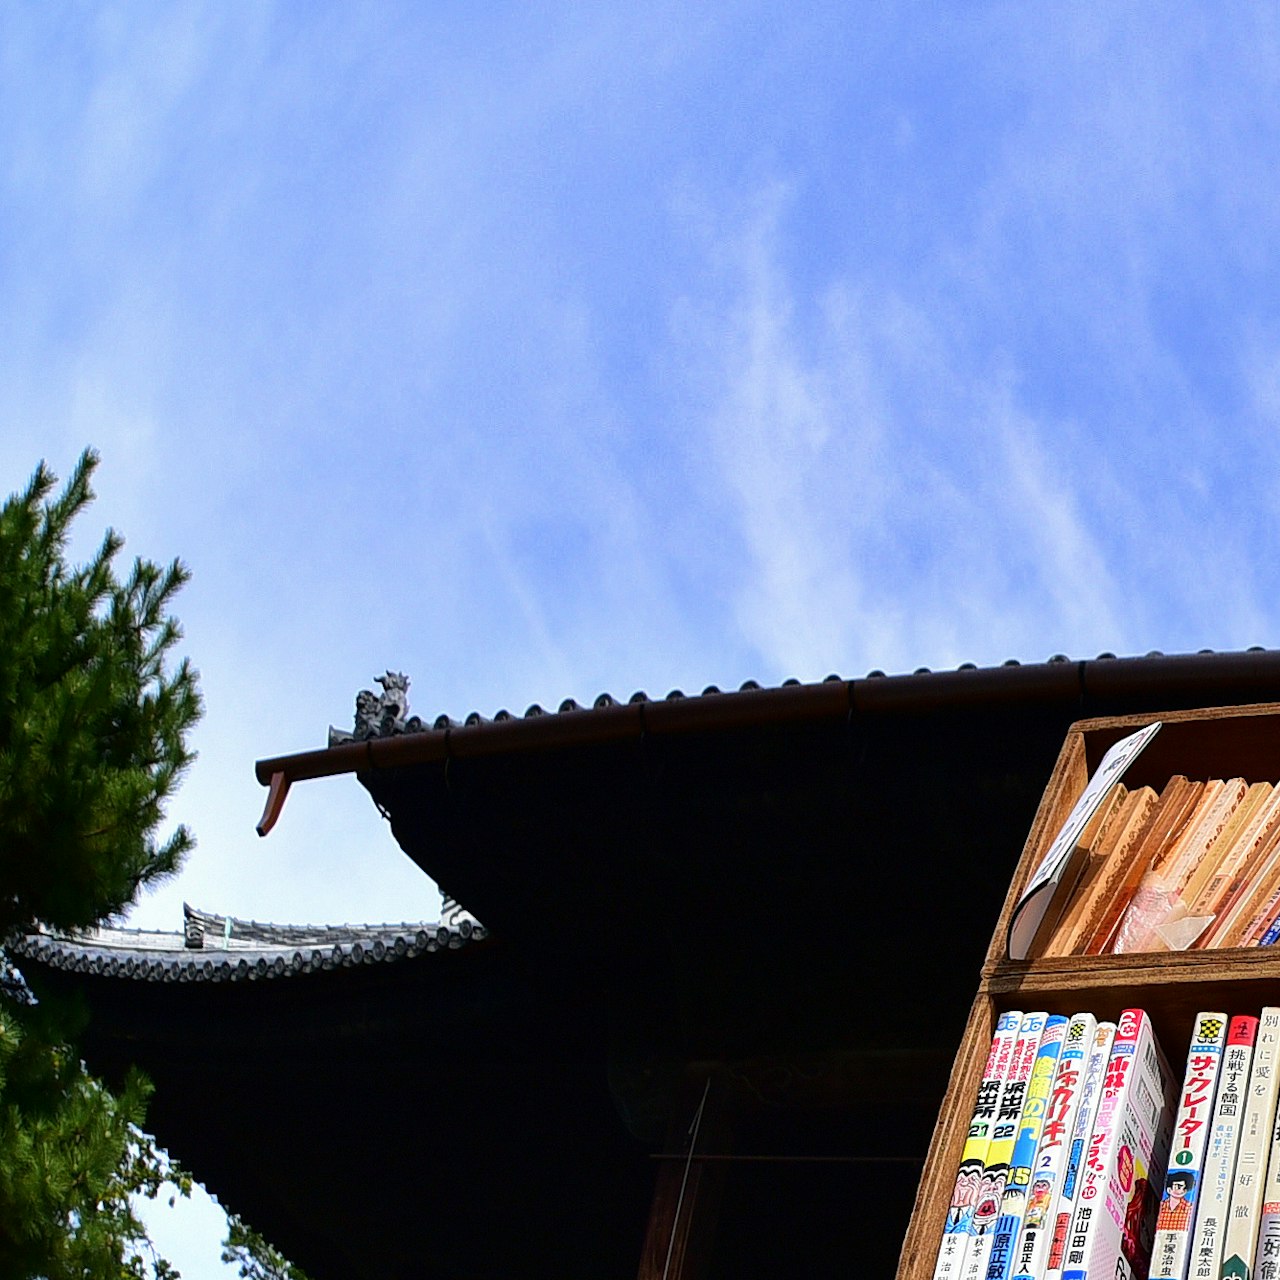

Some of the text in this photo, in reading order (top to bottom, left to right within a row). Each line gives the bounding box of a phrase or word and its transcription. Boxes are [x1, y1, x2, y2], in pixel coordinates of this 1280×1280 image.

[1219, 1050, 1246, 1116] 挑戦する韓国
[1254, 1015, 1278, 1095] 別れに愛を
[975, 1080, 1000, 1120] 派出所
[997, 1081, 1026, 1120] 派出所
[1018, 1055, 1057, 1140] 修羅の門
[1176, 1055, 1216, 1149] ザ・クレーター
[969, 1123, 989, 1138] 21
[994, 1124, 1015, 1138] 22
[1008, 1167, 1030, 1185] 15
[1235, 1152, 1256, 1218] 三好徹
[987, 1216, 1015, 1279] 川原正敏
[1068, 1208, 1092, 1264] 池山田剛
[1159, 1232, 1178, 1277] 手塚治虫
[1195, 1218, 1218, 1277] 長谷川慶太郎
